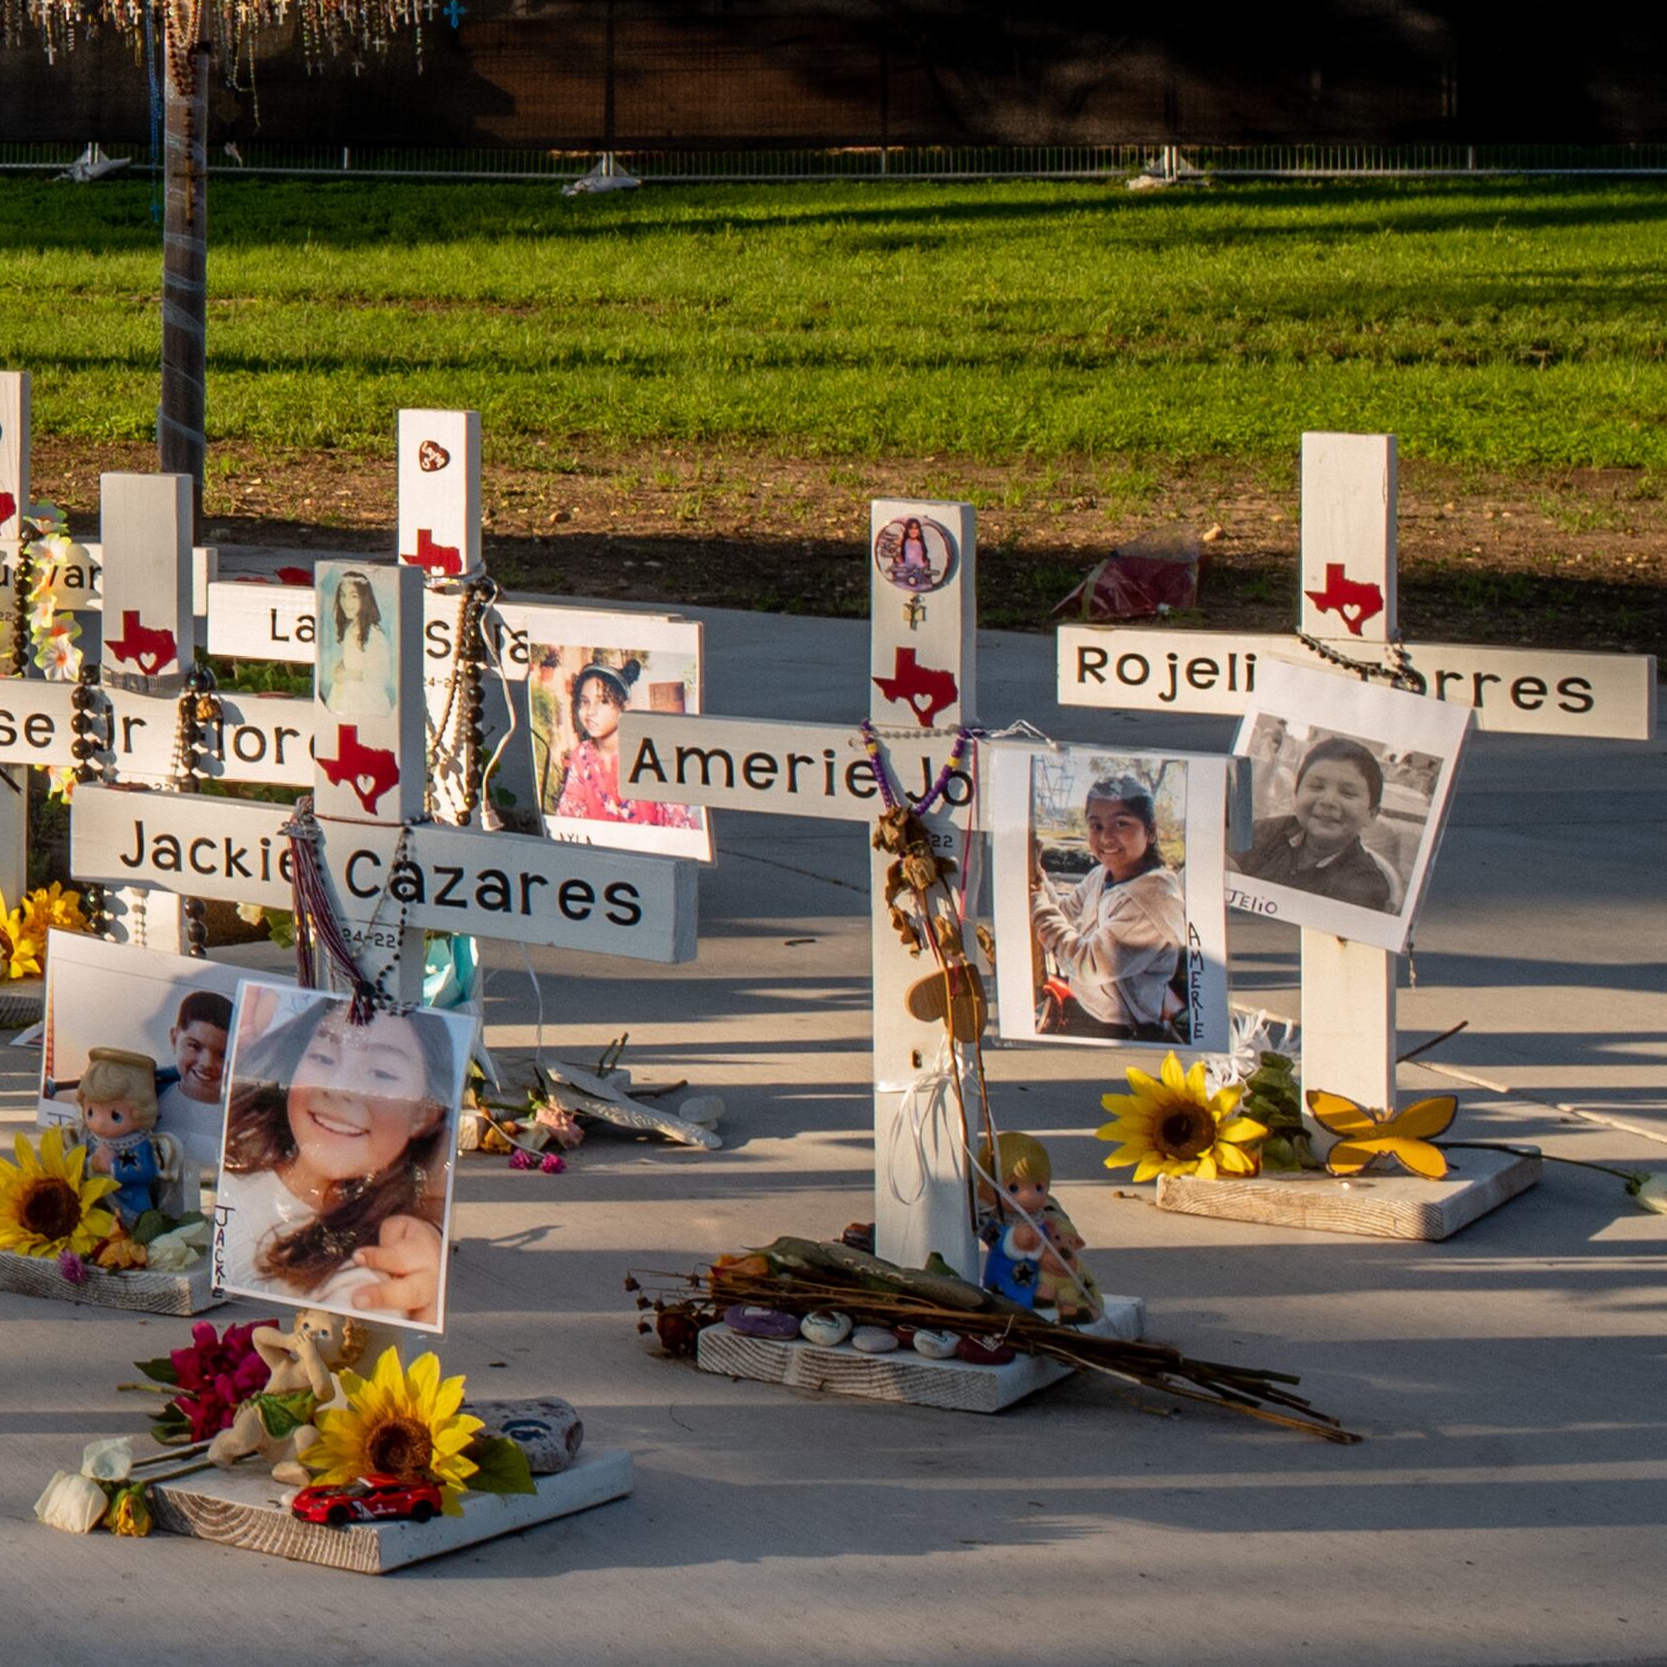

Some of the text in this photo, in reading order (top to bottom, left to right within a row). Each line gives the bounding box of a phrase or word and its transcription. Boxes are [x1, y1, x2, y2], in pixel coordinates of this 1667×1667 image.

[1076, 644, 1257, 703] Rojeli
[628, 737, 877, 800] Amerie
[119, 820, 643, 927] Jackie Cazares
[1186, 919, 1206, 1041] AMERIE
[212, 1205, 236, 1299] JACKIE
